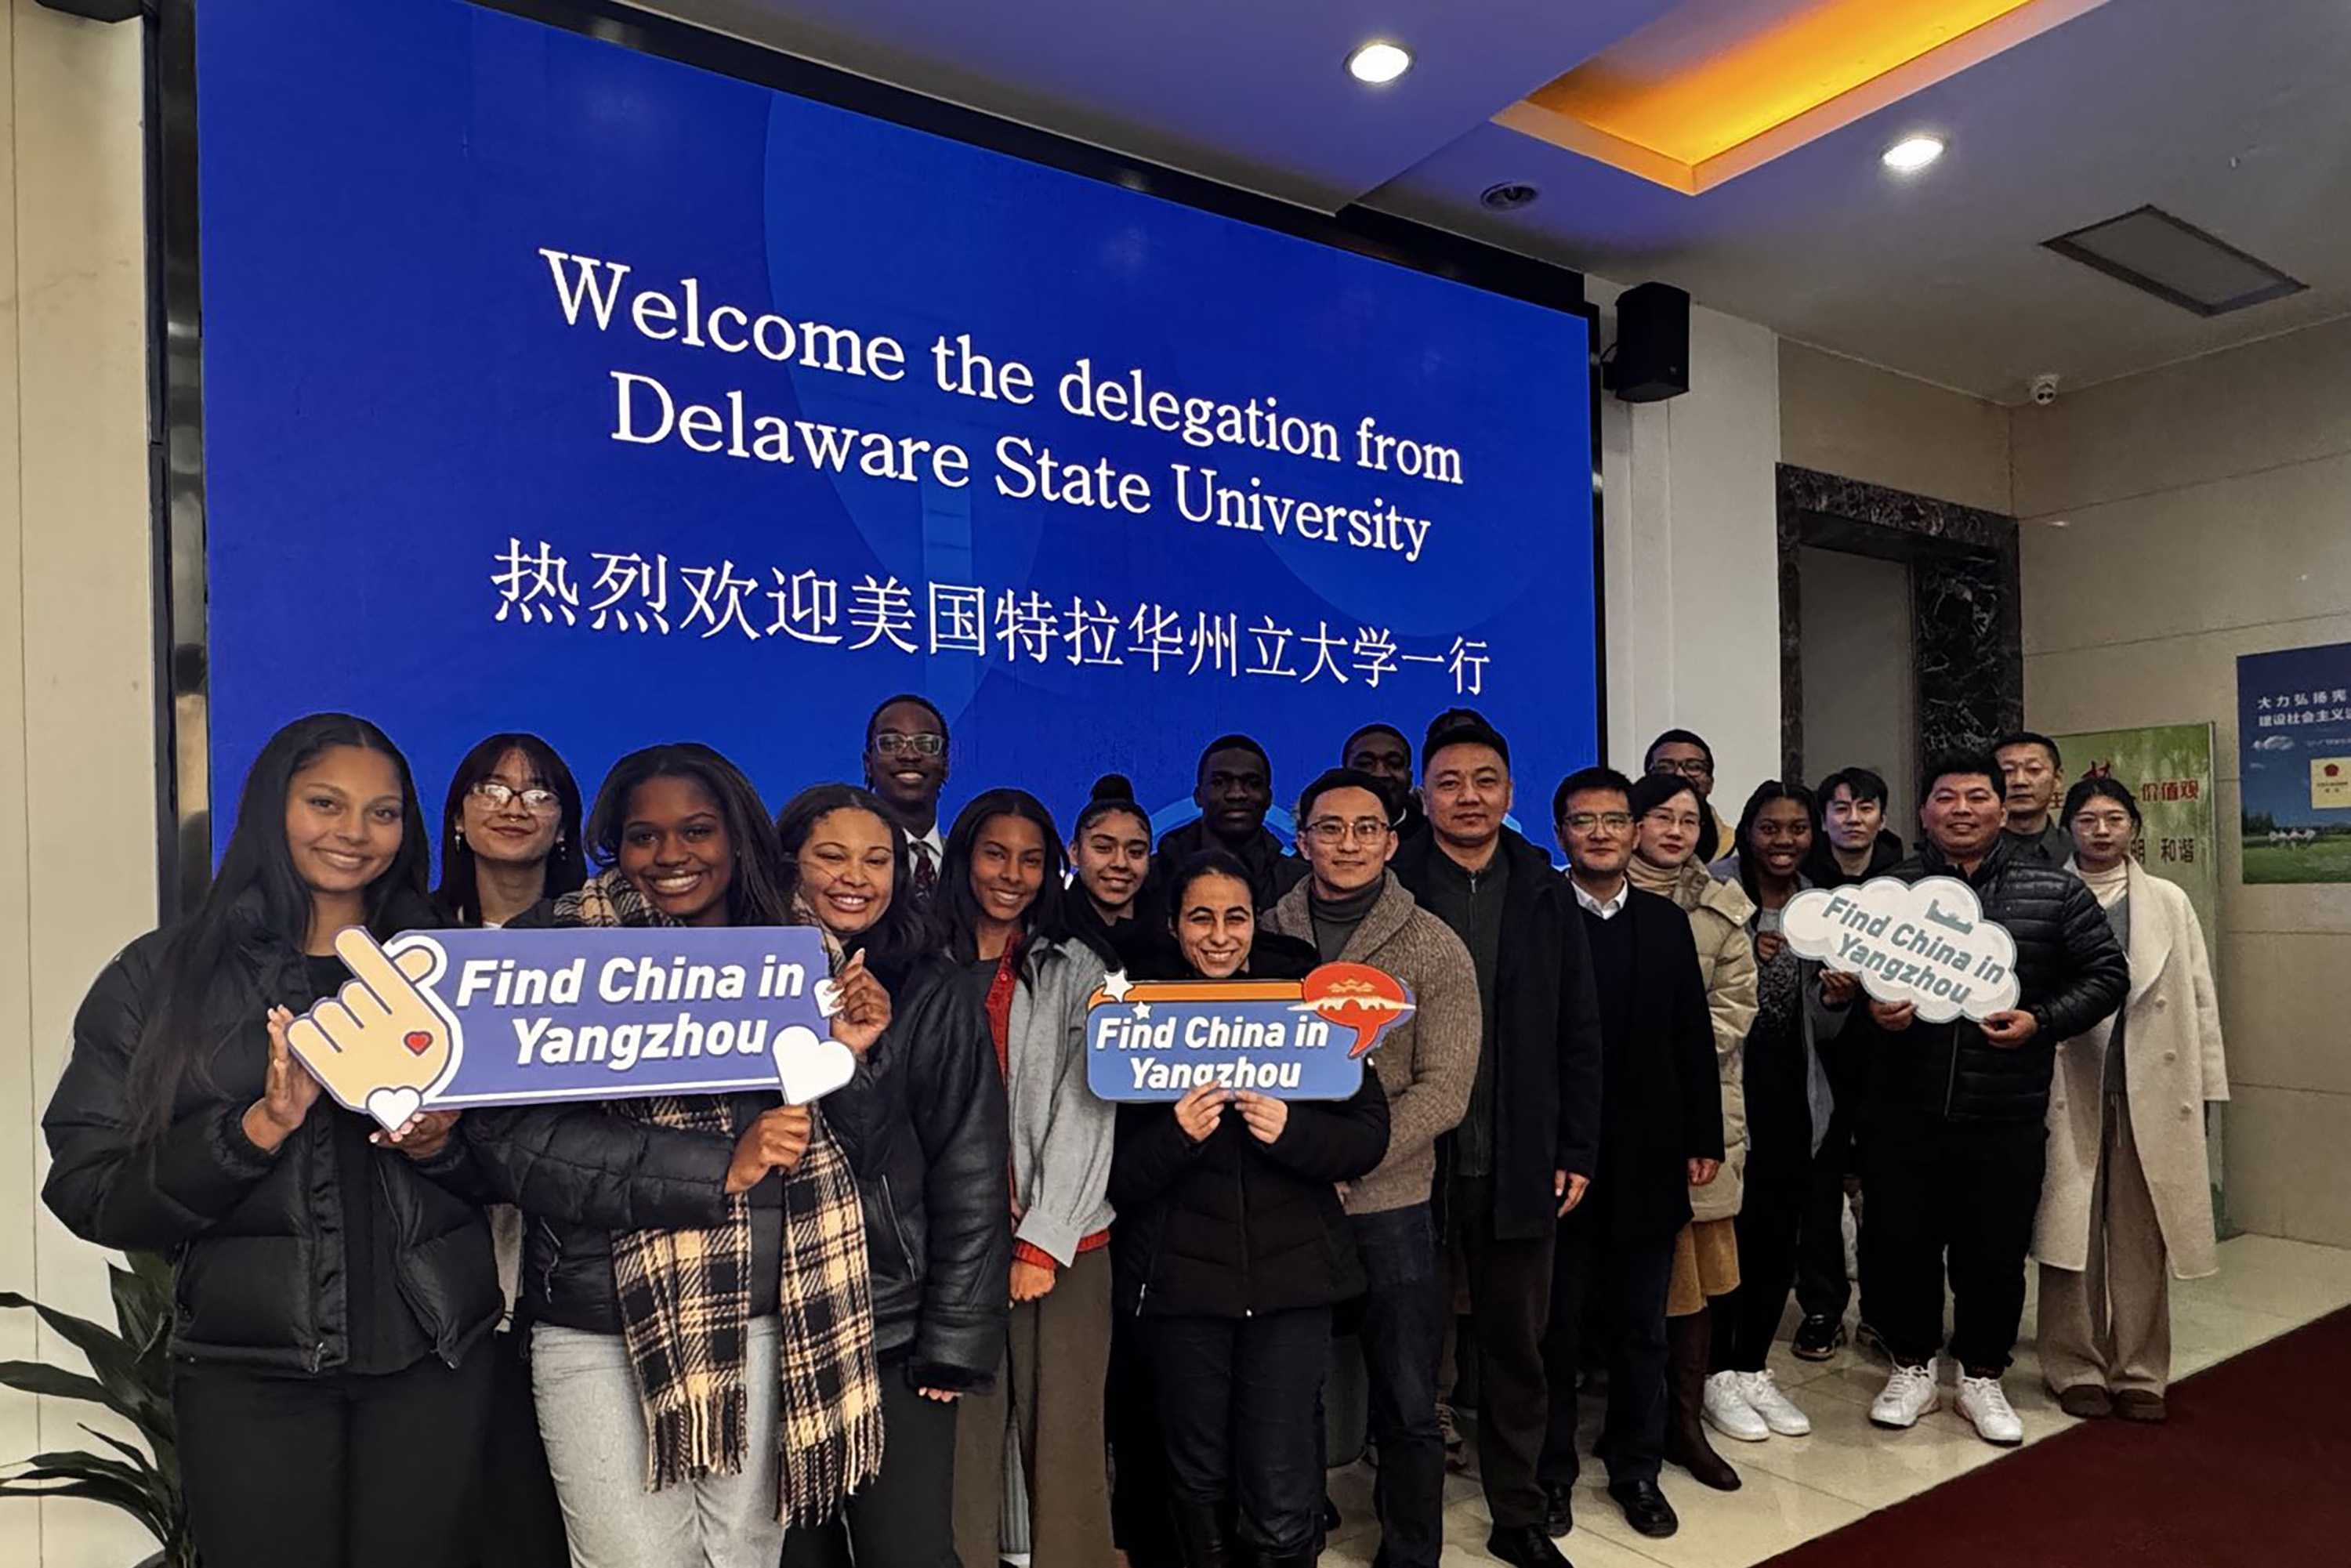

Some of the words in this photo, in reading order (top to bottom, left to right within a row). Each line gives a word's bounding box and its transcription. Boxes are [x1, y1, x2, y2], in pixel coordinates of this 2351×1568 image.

[539, 248, 905, 381] Welcome
[931, 335, 1034, 404] the
[1060, 358, 1341, 468] delegation
[1357, 416, 1464, 484] from
[610, 371, 969, 487] Delaware
[995, 436, 1151, 514] State
[1171, 463, 1432, 562] University
[491, 538, 1491, 695] 热烈欢迎美国特拉华州立大学一行
[456, 958, 586, 1006] Find
[599, 957, 746, 1002] China
[759, 954, 805, 997] in
[1822, 896, 1893, 938] Find
[1890, 923, 1972, 972] China
[1973, 955, 2005, 984] in
[1837, 932, 1972, 1005] Yangzhou
[513, 1013, 768, 1070] Yangzhou
[1096, 1017, 1176, 1049] Find
[1185, 1016, 1285, 1048] China
[1295, 1015, 1329, 1047] in
